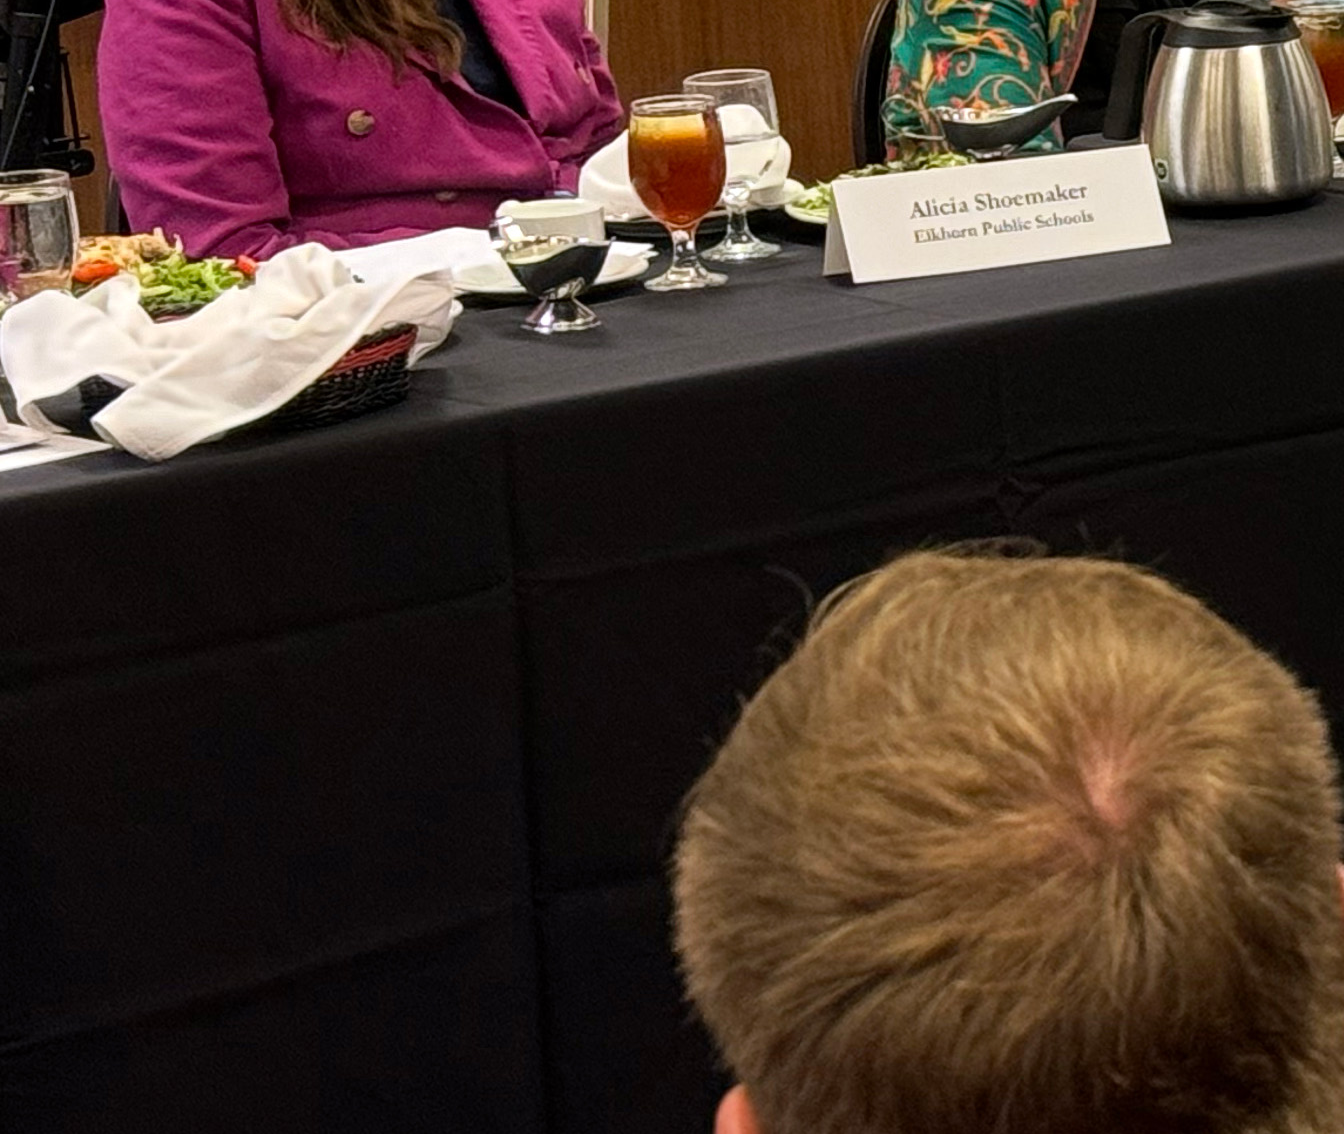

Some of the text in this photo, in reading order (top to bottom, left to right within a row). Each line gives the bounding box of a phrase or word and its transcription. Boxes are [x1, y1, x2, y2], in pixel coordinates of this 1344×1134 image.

[909, 184, 1088, 220] Alicia Shoemaker
[913, 209, 1094, 244] Elkhorn Public Schools
